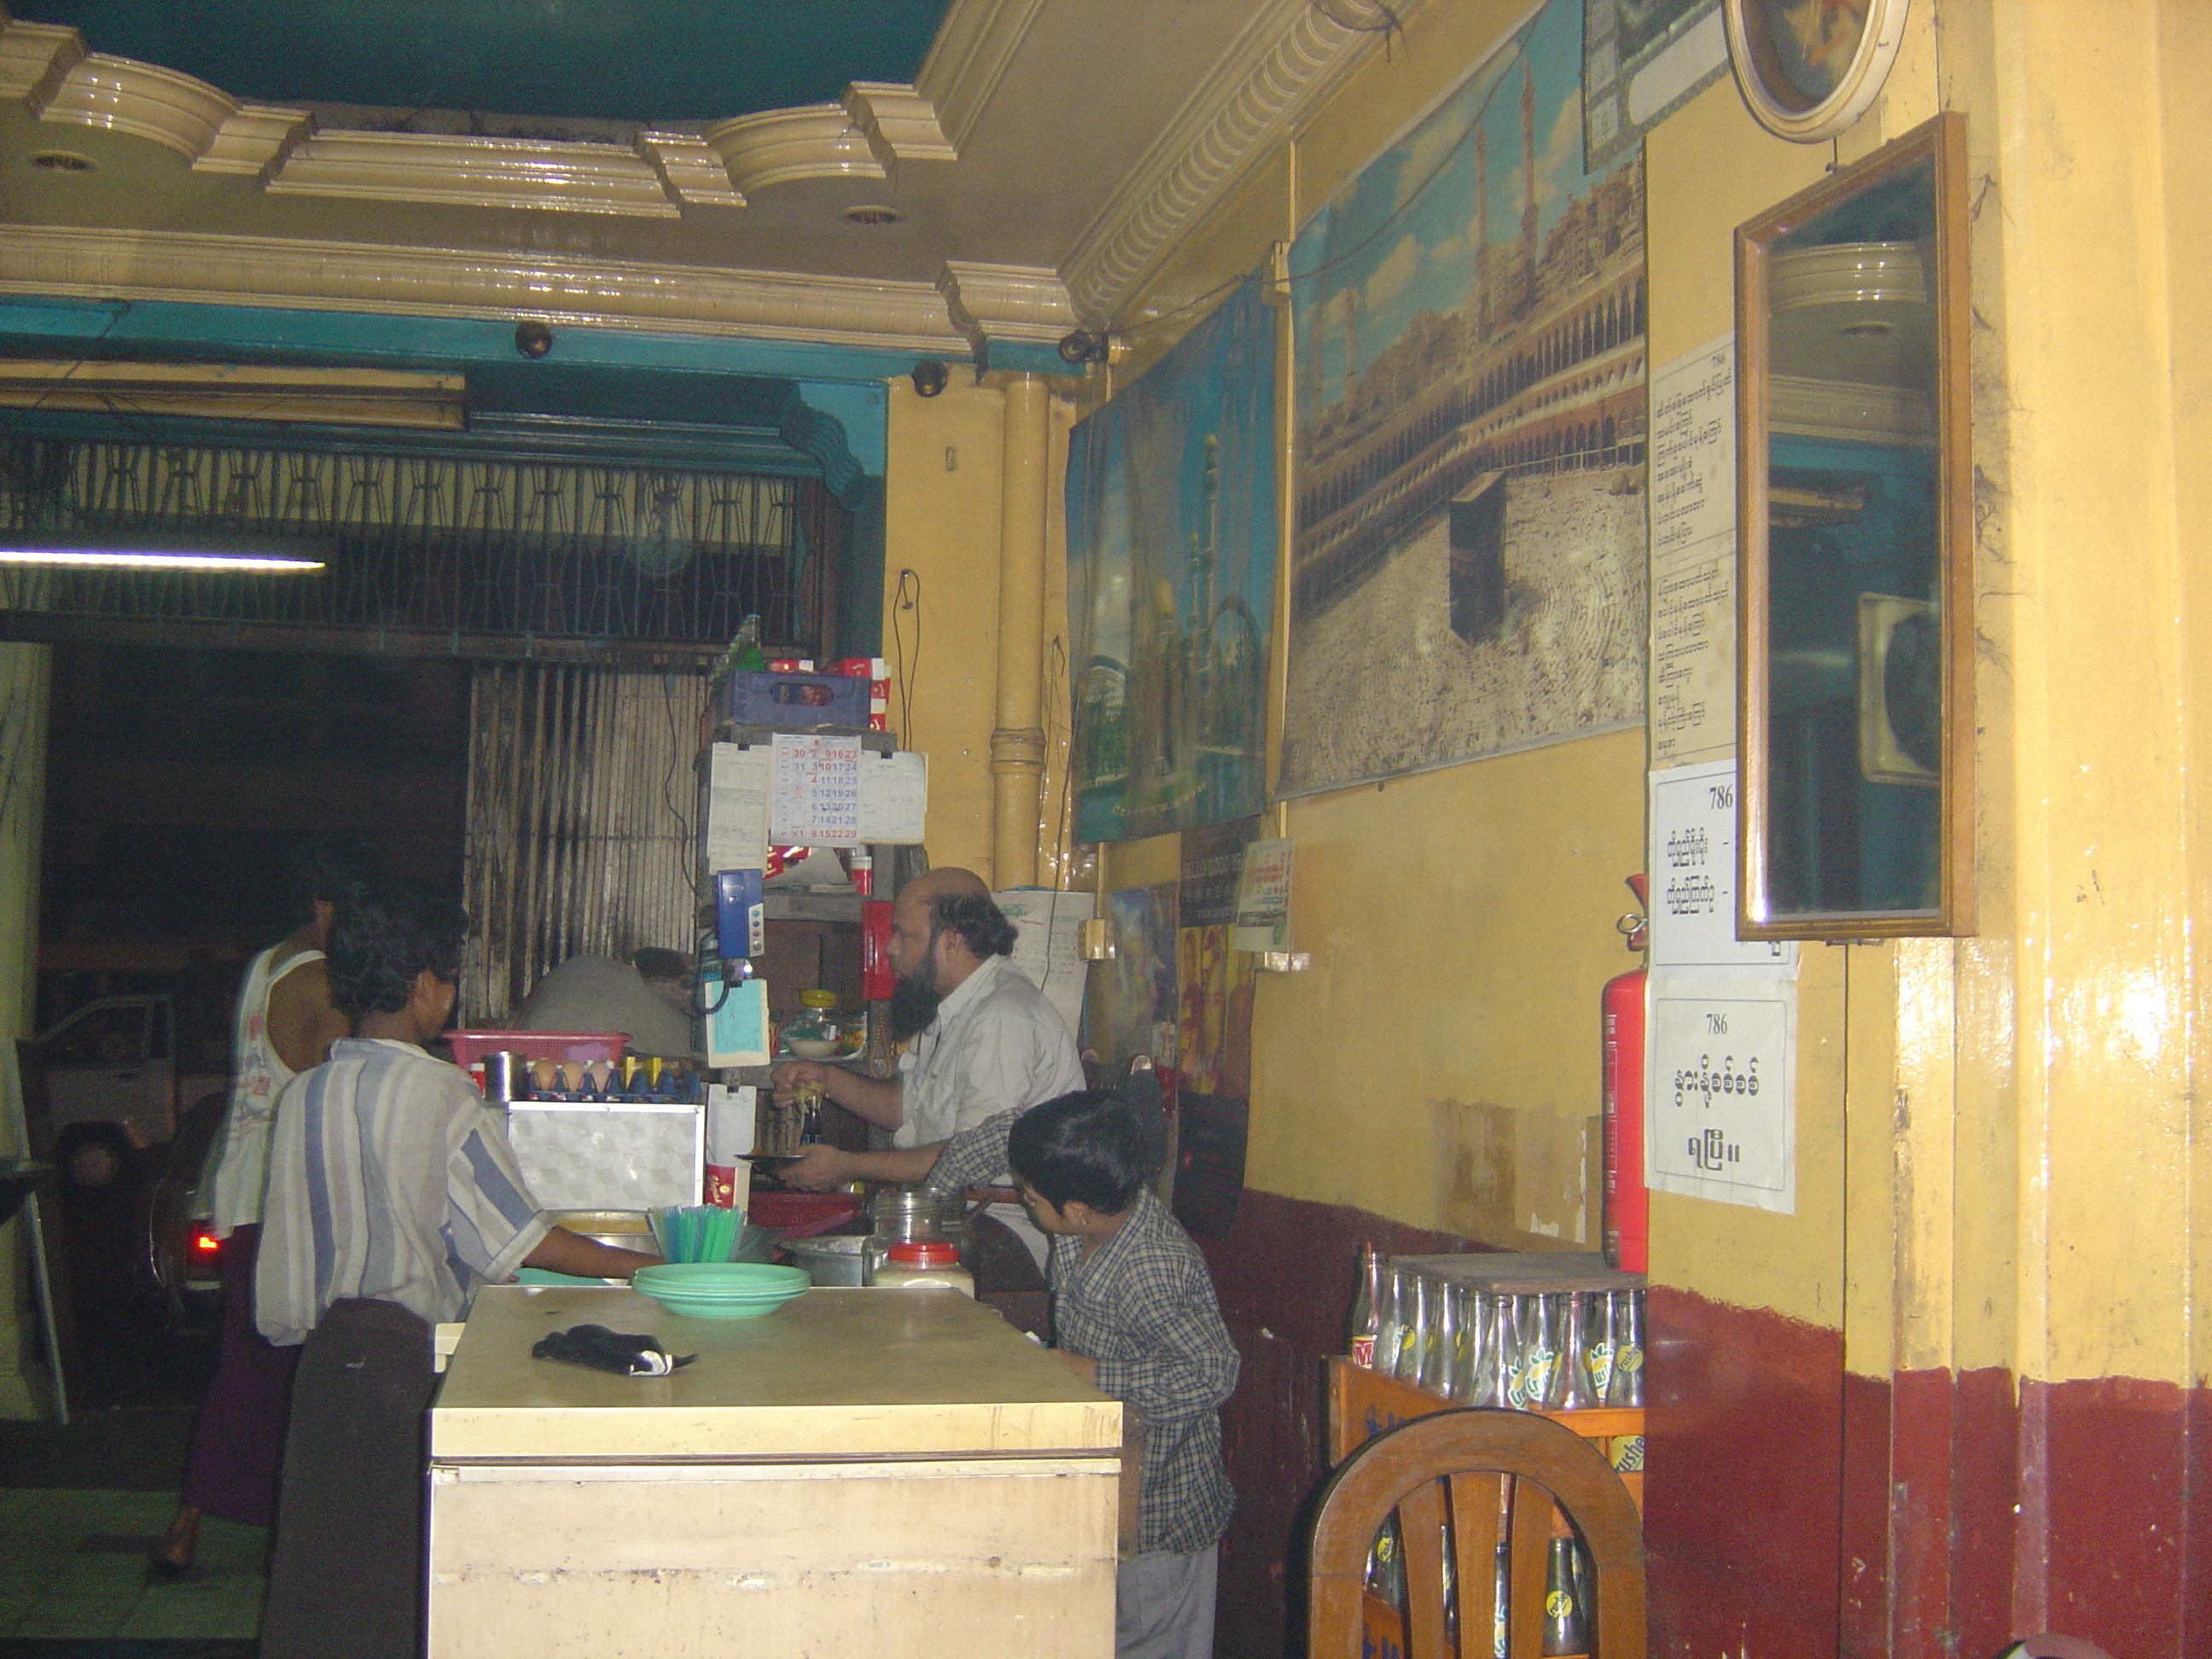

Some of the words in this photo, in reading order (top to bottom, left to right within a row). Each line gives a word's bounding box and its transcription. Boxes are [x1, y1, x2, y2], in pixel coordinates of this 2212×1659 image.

[794, 749, 805, 758] 30
[833, 749, 843, 758] 16
[845, 750, 857, 759] 23
[794, 762, 805, 771] 31
[833, 763, 843, 771] 17
[845, 763, 857, 771] 24
[812, 775, 818, 784] 4
[1709, 784, 1733, 810] 786
[832, 816, 842, 824] 21
[844, 816, 856, 824] 28
[1707, 1013, 1727, 1034] 786
[1674, 1053, 1760, 1109] နွားနို့စစ်စစ်
